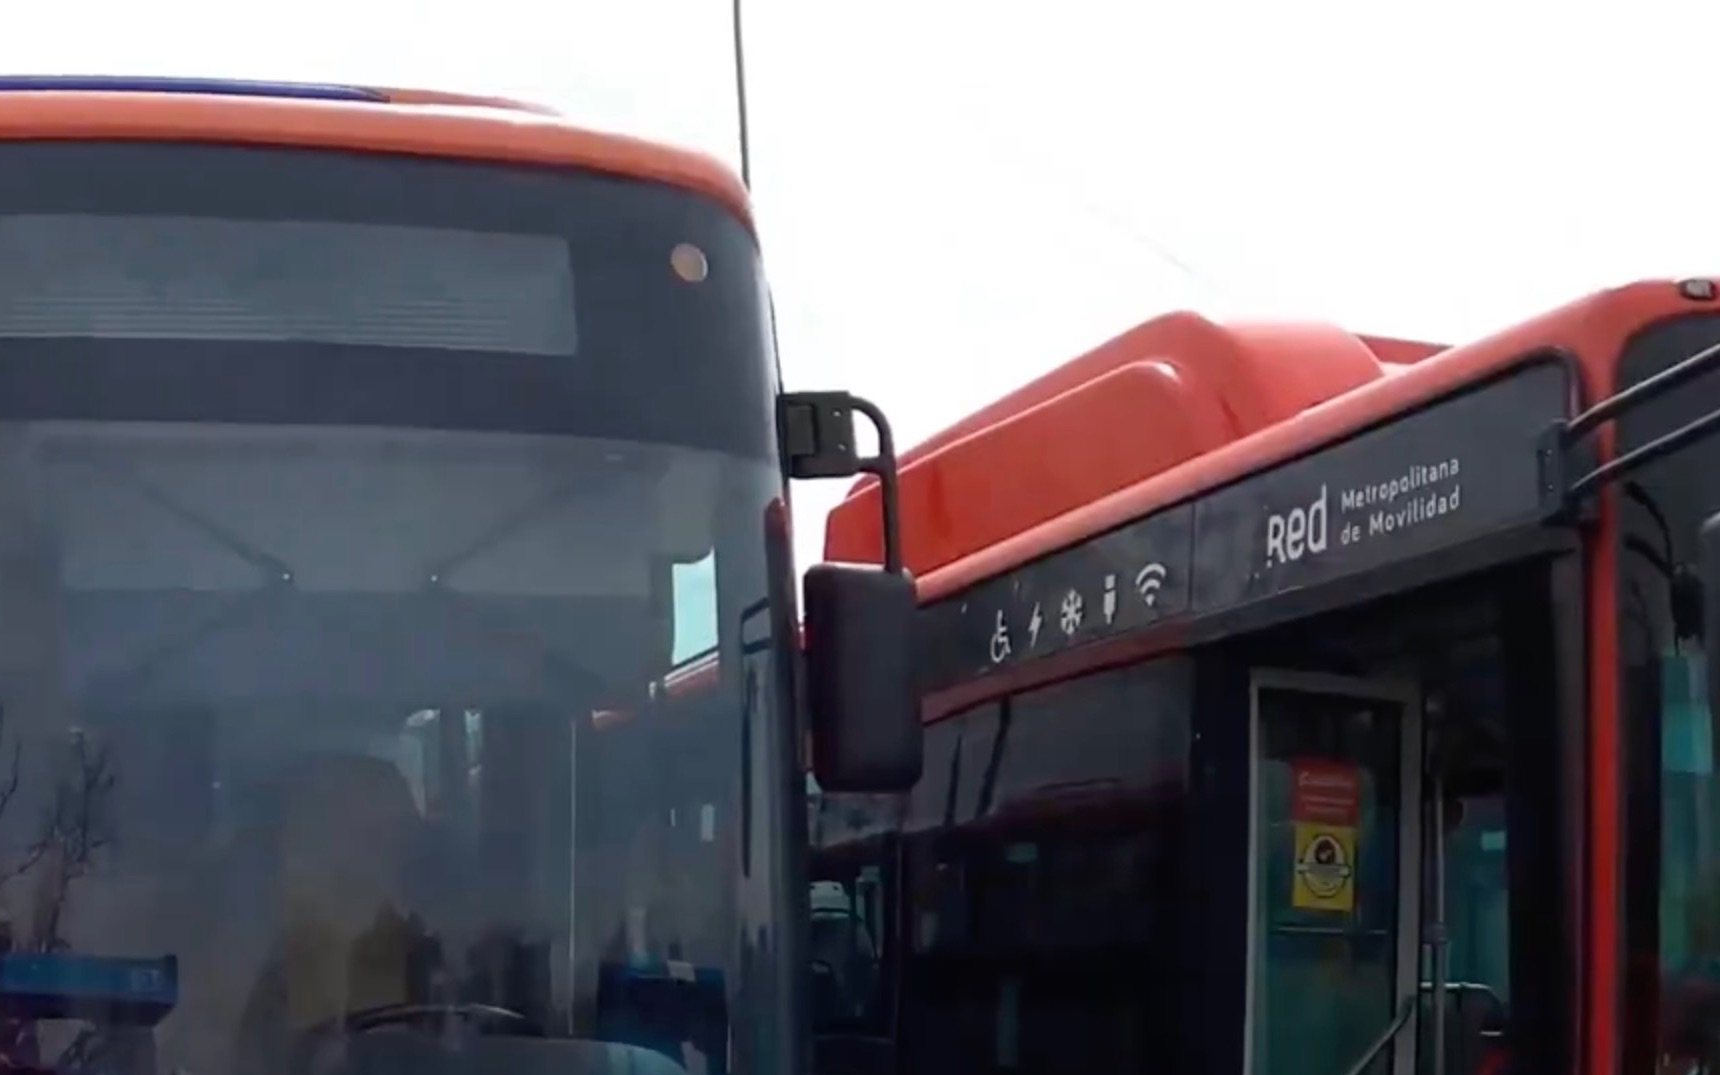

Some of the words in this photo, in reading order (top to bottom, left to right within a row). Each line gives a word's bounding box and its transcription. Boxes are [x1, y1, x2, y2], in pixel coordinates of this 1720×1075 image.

[1340, 458, 1460, 512] Metropolitana
[1341, 521, 1361, 546] de
[1368, 483, 1461, 537] Movilidad
[1266, 482, 1327, 565] Red
